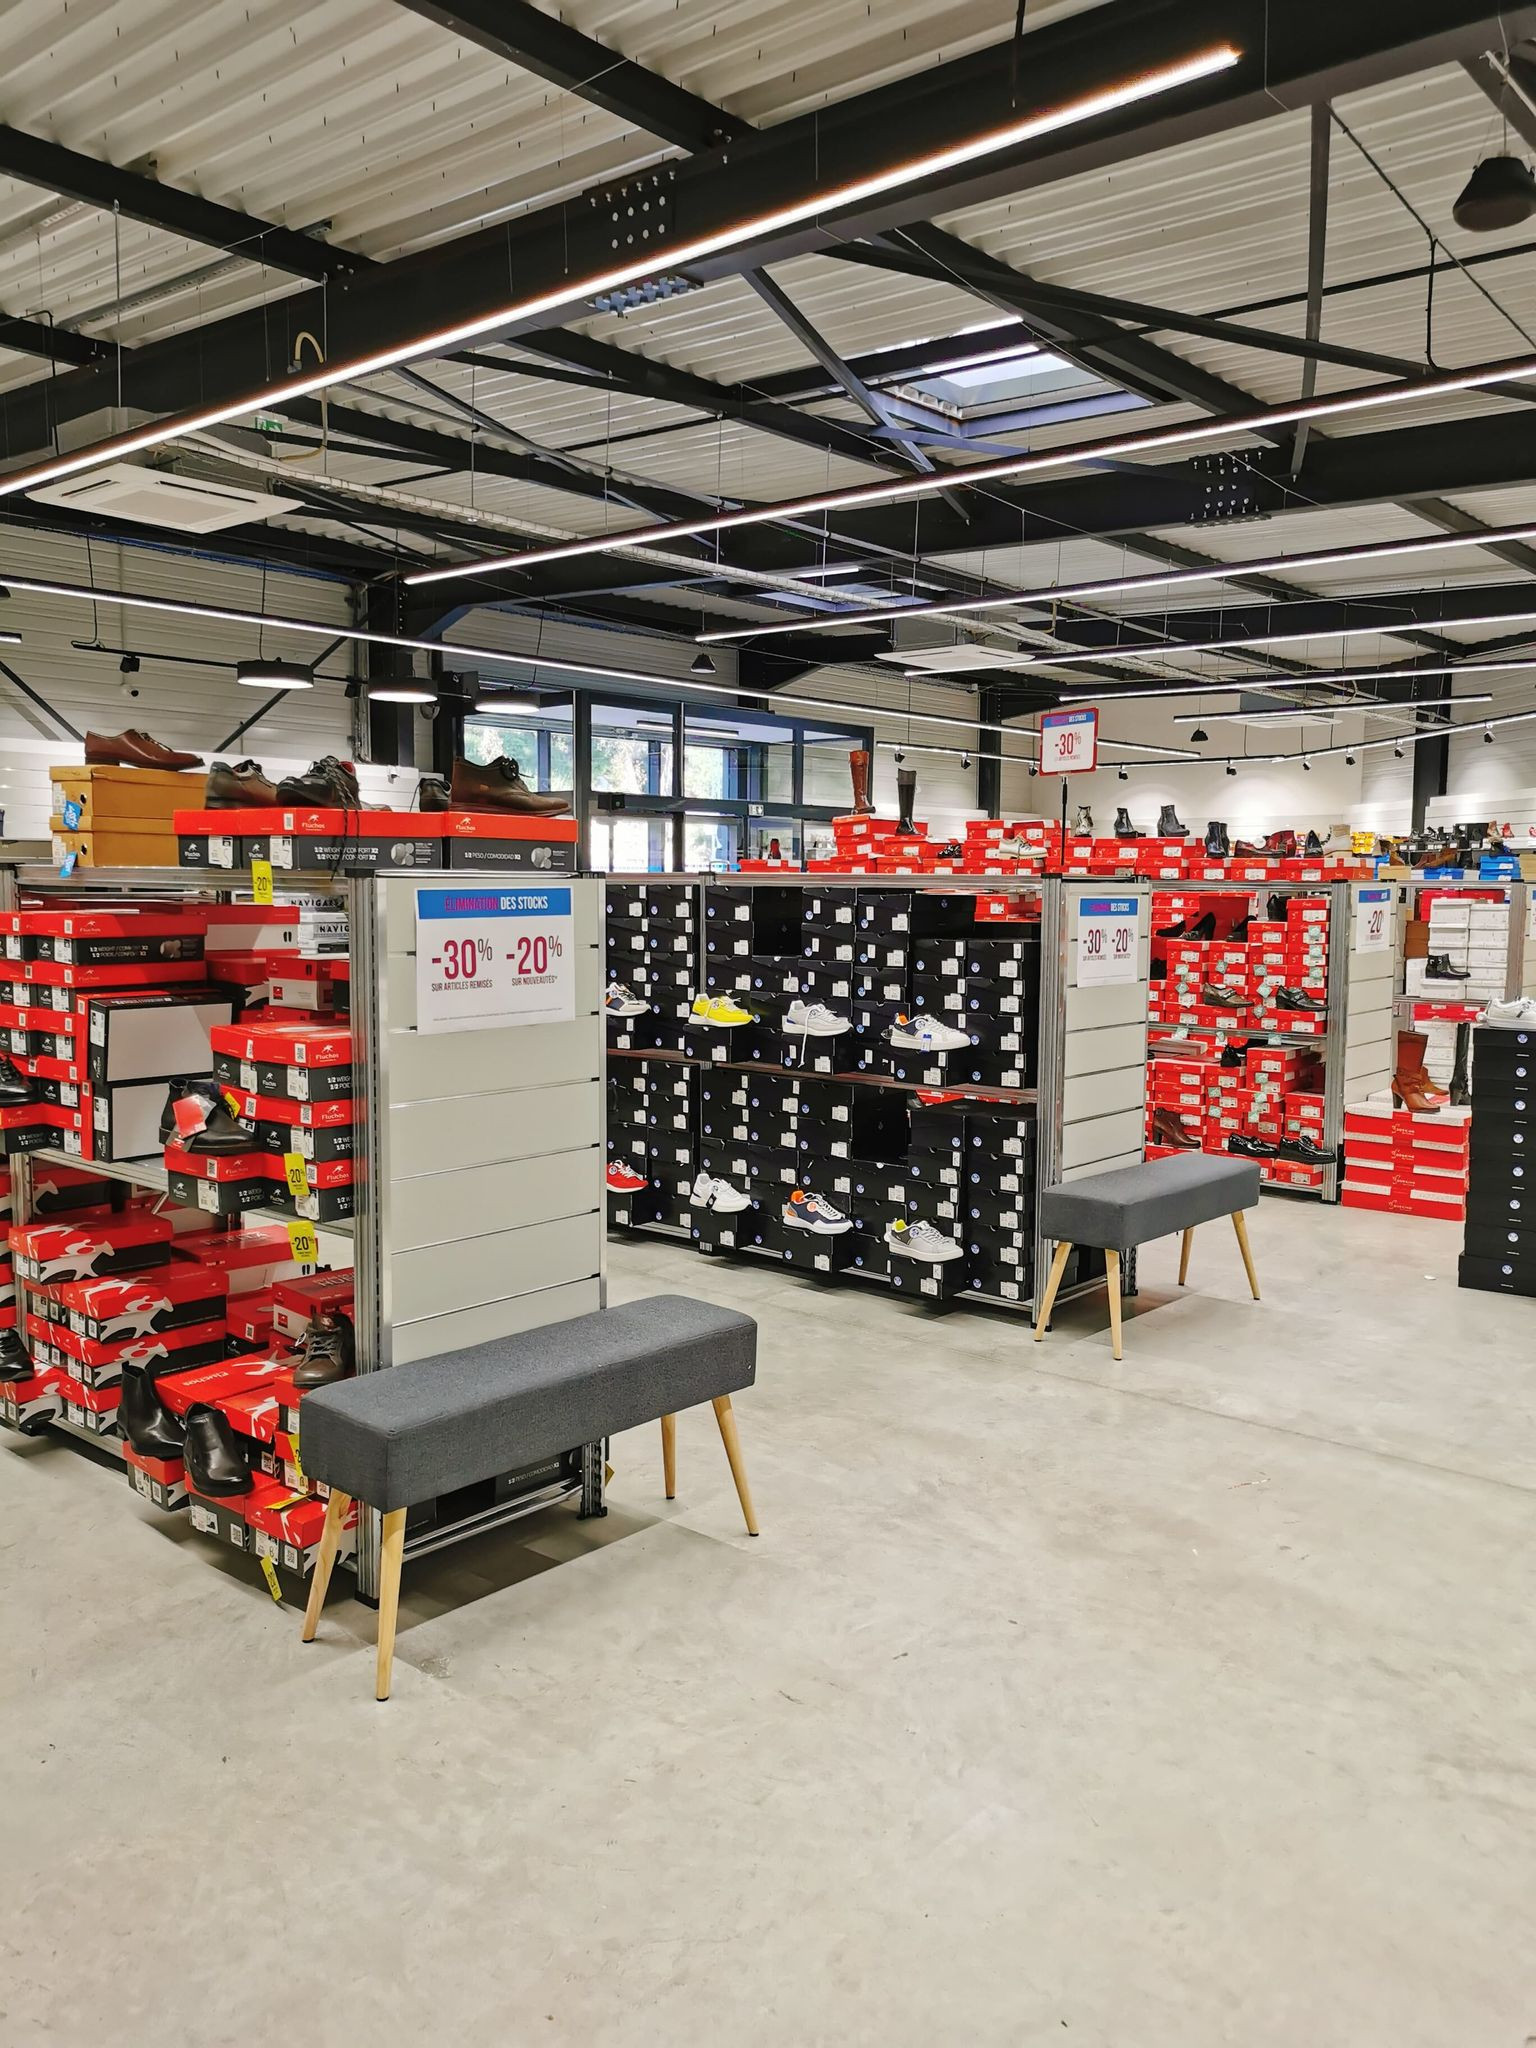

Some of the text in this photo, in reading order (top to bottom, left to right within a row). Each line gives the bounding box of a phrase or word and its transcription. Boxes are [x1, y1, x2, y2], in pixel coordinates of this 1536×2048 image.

[1055, 731, 1082, 756] -30%
[301, 821, 326, 830] Fluchos
[455, 824, 476, 832] Fluchos
[500, 898, 516, 910] DES
[517, 896, 549, 910] STOCKS
[431, 935, 563, 980] -30% -20%
[431, 978, 493, 992] SUR ARTICLES REMISÉS
[511, 977, 522, 986] SUR
[321, 1112, 345, 1120] Fluchos
